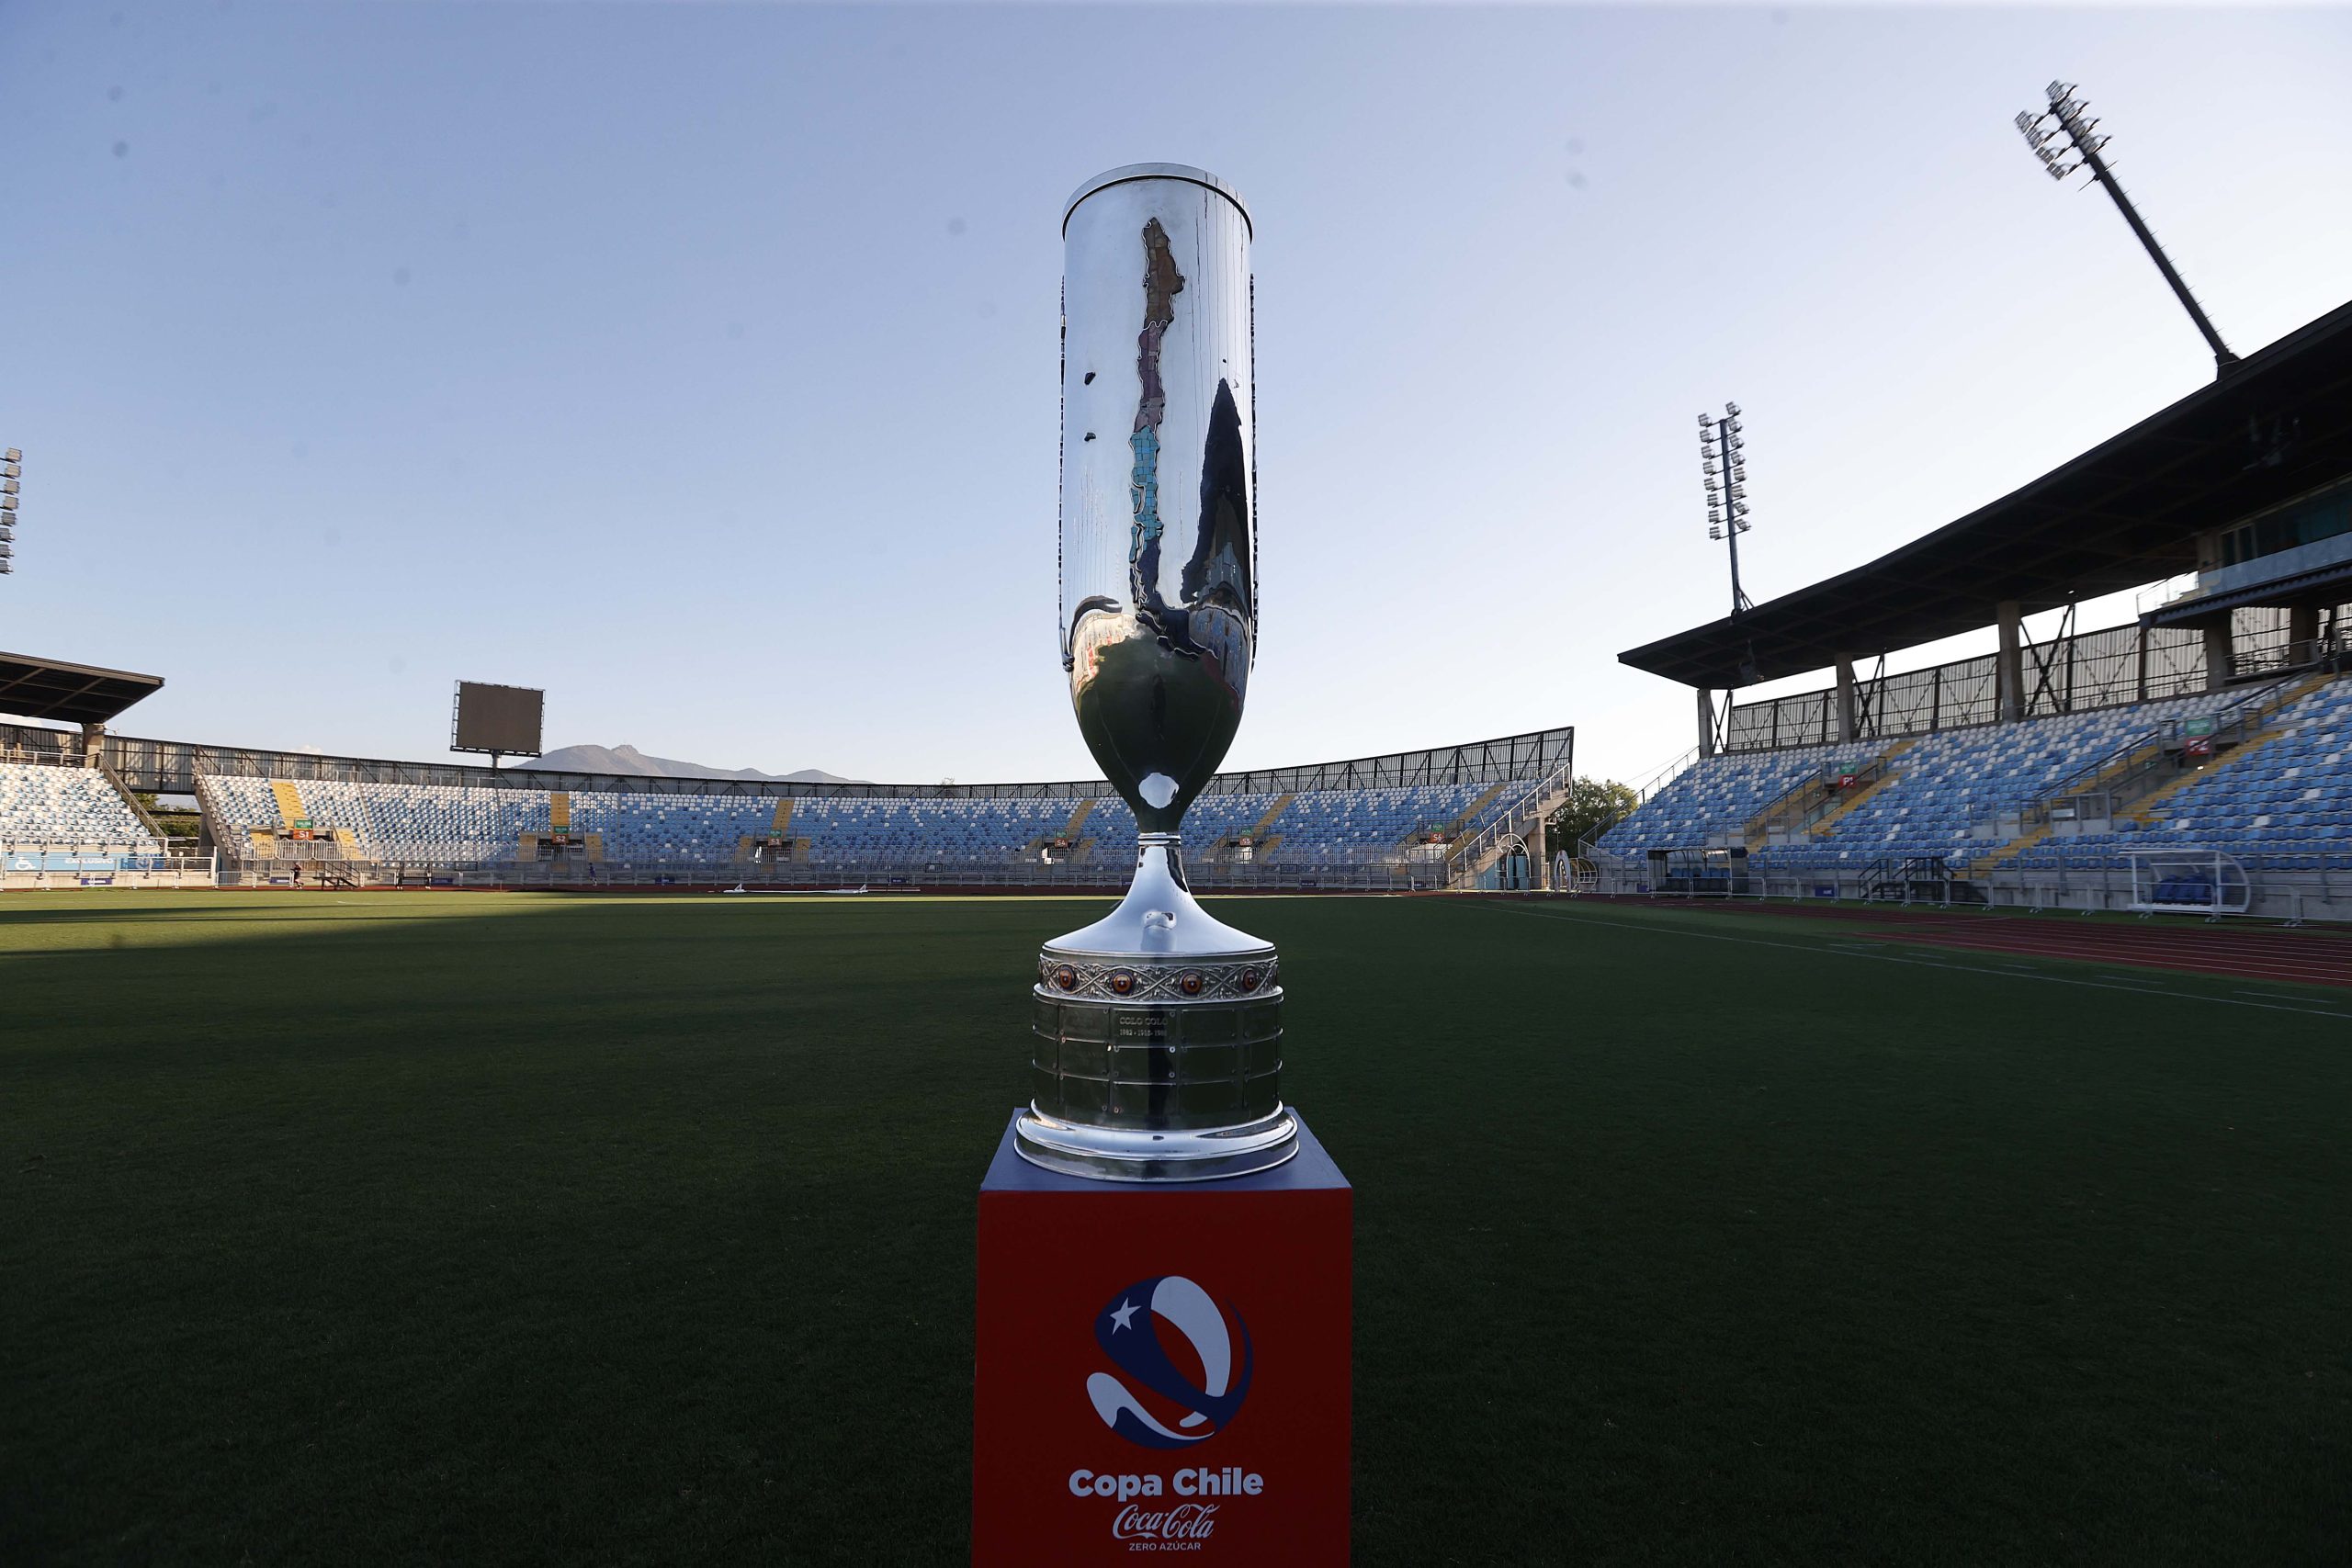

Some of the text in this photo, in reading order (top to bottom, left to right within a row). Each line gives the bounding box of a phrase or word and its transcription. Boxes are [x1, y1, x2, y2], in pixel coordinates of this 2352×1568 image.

[1433, 833, 1442, 841] S6
[1119, 1017, 1168, 1026] COLO COLO
[1069, 1467, 1264, 1503] Copa Chile
[1128, 1540, 1201, 1551] ZERO AZÚCAR
